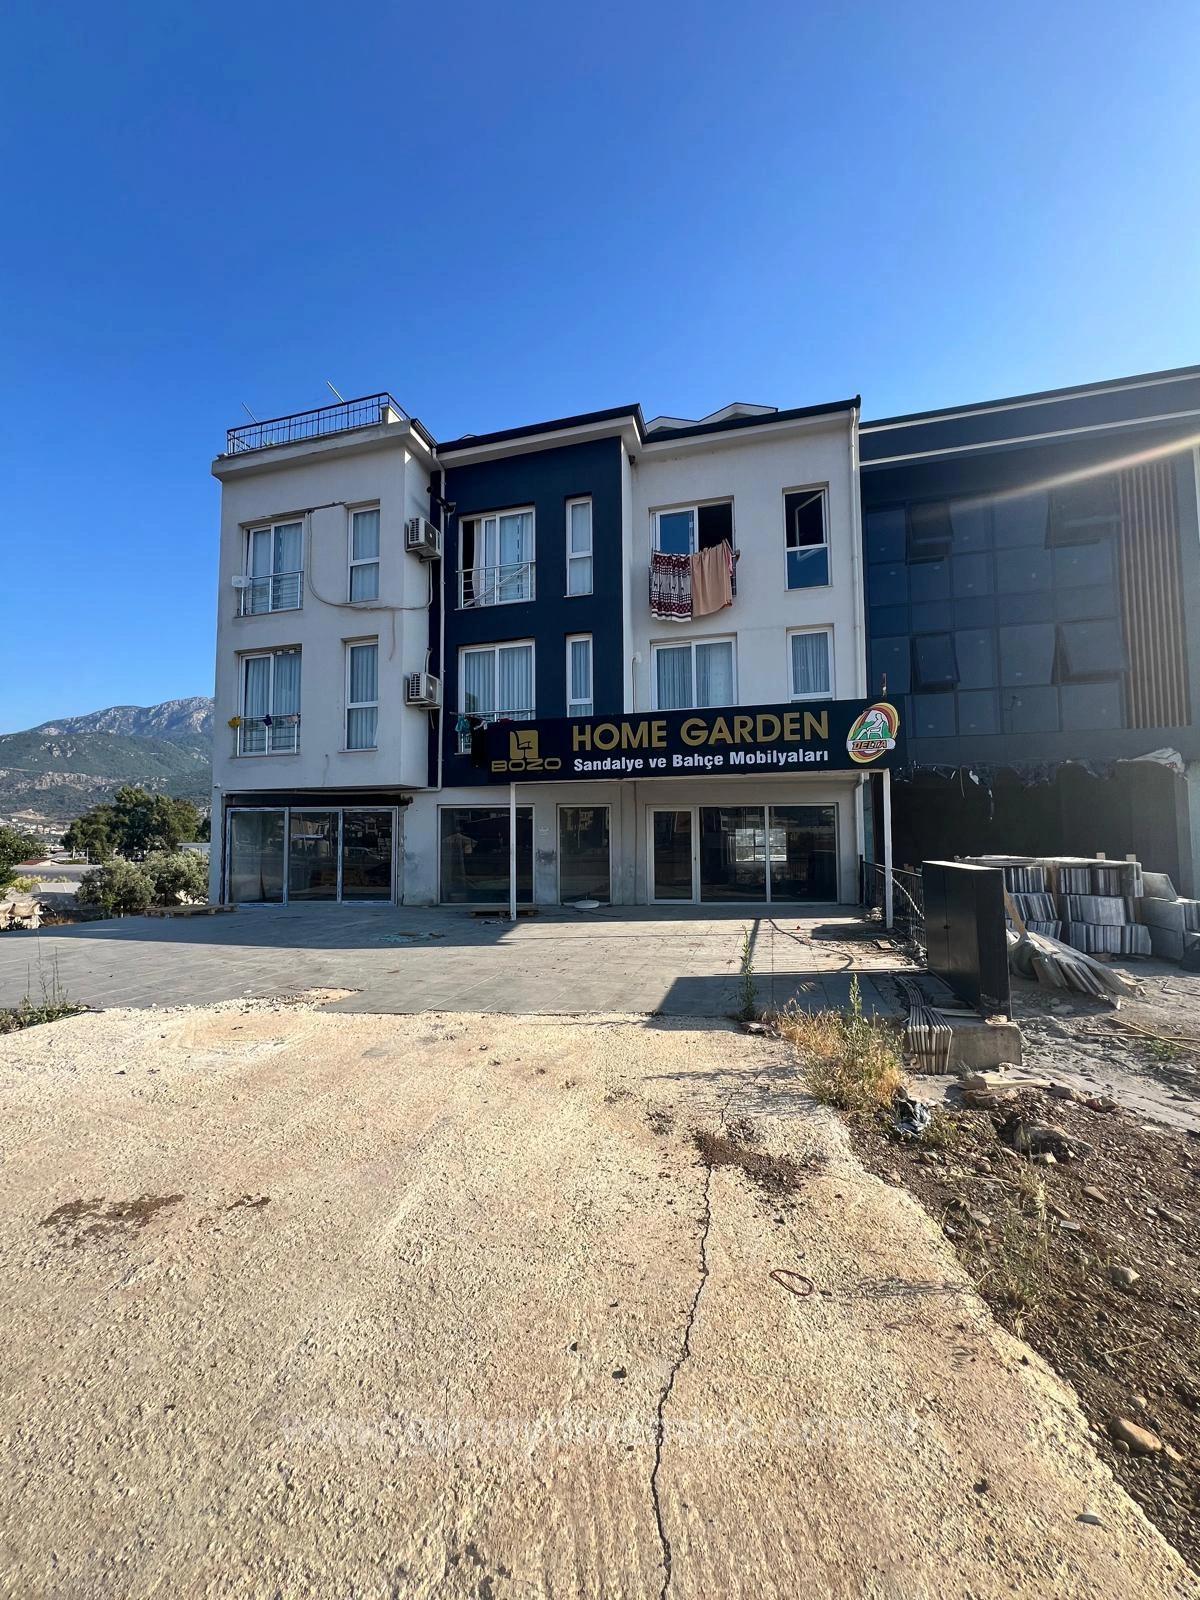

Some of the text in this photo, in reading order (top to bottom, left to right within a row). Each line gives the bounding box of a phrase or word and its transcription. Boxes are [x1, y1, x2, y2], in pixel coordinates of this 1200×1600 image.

[572, 710, 829, 752] HOME GARDEN
[491, 757, 562, 773] BOZO
[573, 748, 829, 772] Sandalye ve Bahçe Mobilyaları
